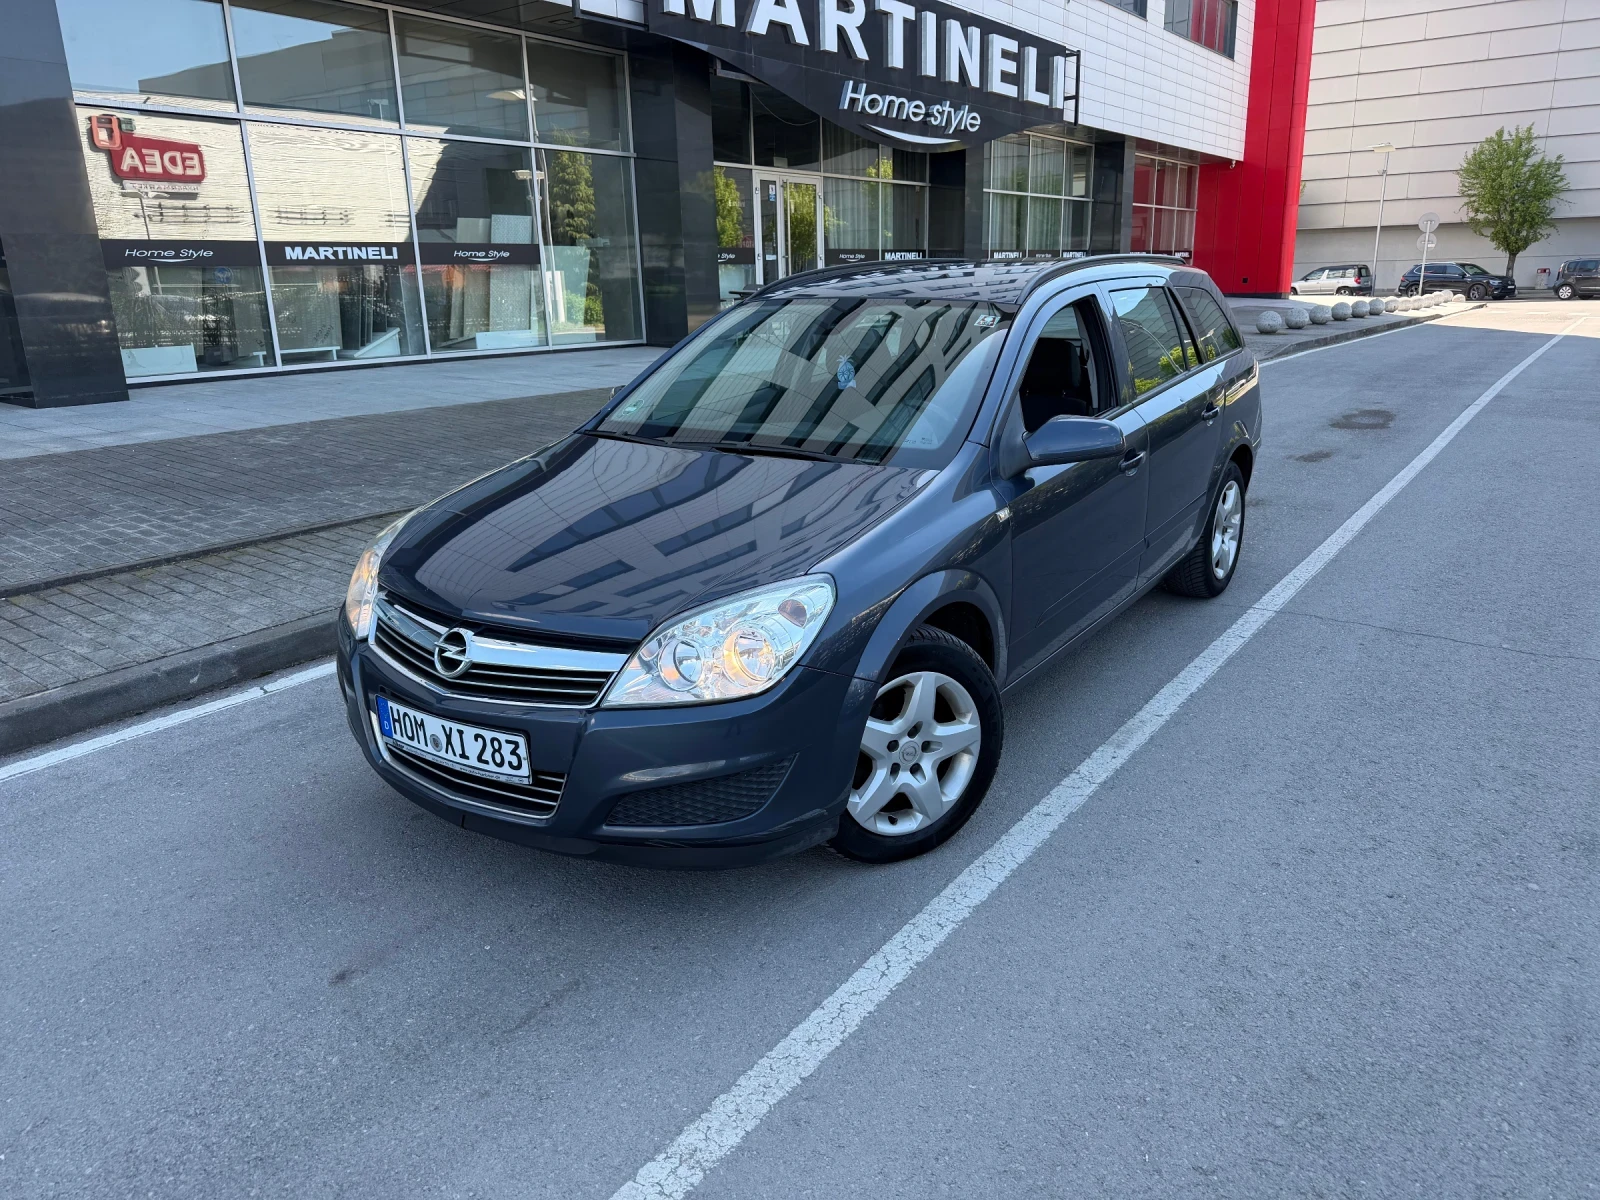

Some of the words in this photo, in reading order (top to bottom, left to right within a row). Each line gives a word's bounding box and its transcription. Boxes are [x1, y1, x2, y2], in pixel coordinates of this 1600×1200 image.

[840, 80, 925, 122] Home
[929, 101, 981, 134] style
[125, 249, 174, 257] Home
[180, 249, 214, 260] Style
[285, 246, 398, 260] MARTINELI
[488, 250, 510, 259] Style
[884, 251, 922, 260] MARTINELI
[390, 705, 428, 747] HOM
[441, 724, 470, 760] XI
[473, 733, 523, 771] 283
